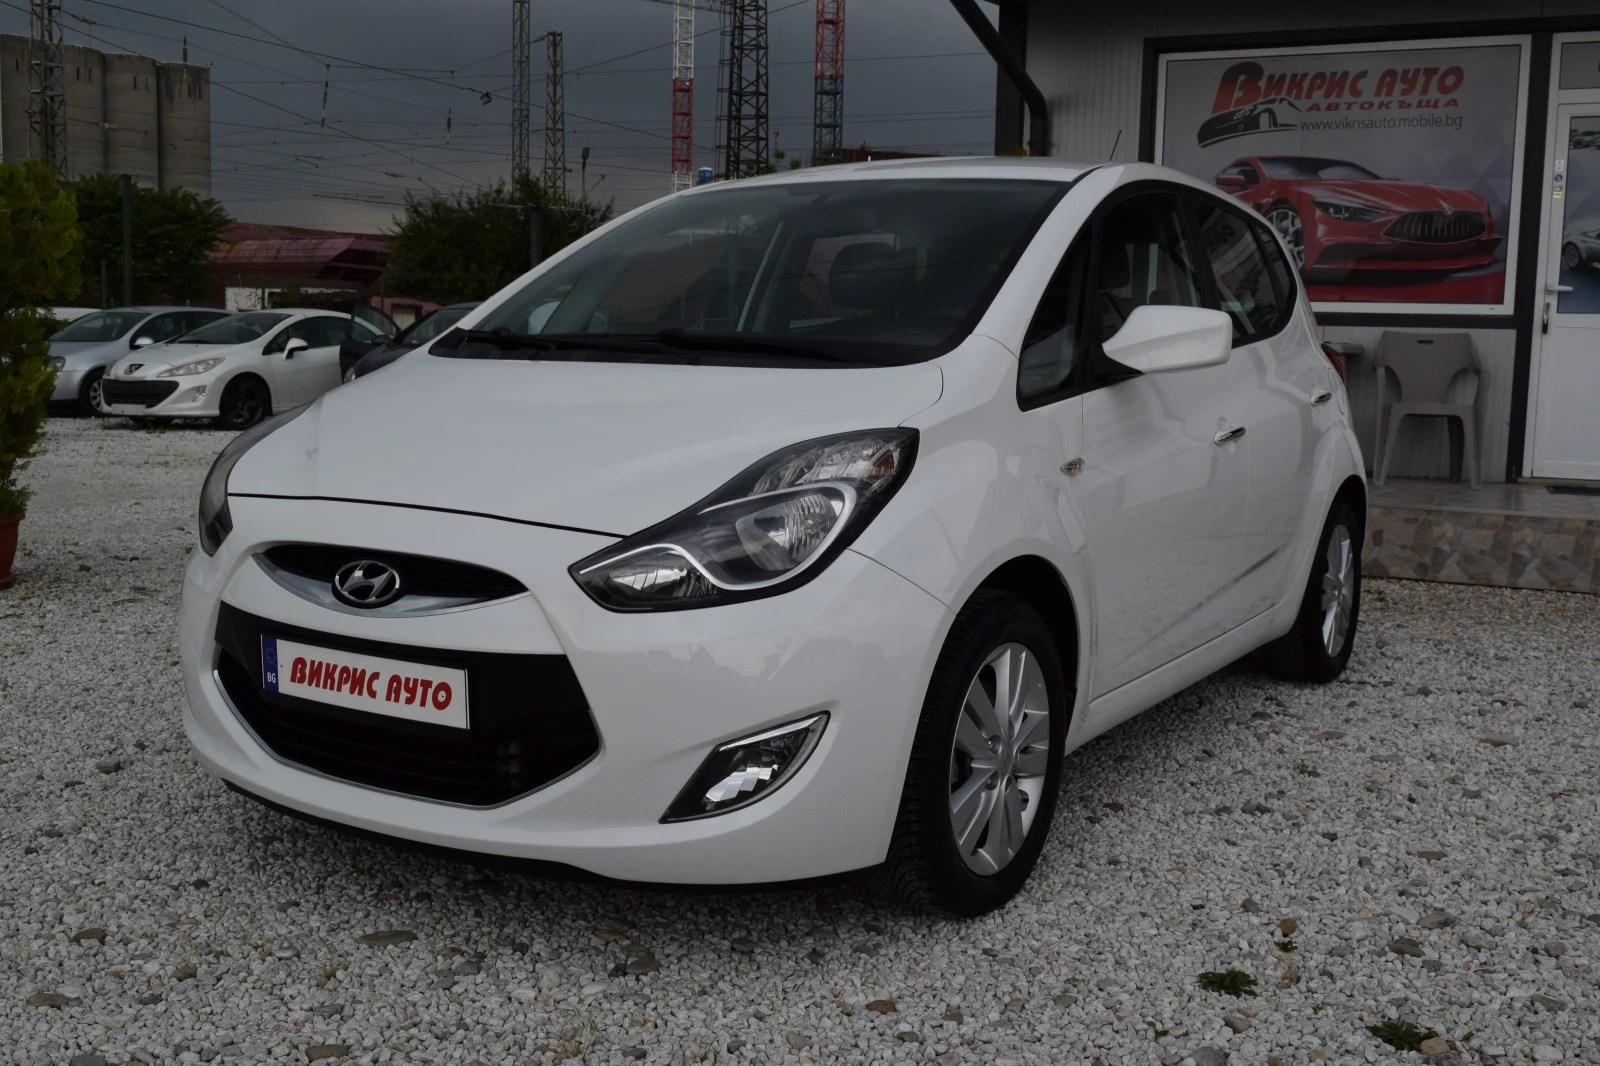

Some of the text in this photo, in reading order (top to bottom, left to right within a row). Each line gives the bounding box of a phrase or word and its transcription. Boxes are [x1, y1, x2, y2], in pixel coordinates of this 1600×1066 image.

[1374, 66, 1465, 98] АУТО
[1306, 98, 1460, 112] АВТОКЪЩА
[1300, 113, 1463, 131] www.vikrisauto.mobile.bg
[266, 671, 277, 684] BG
[290, 656, 453, 711] ВИКРИС АУТО
